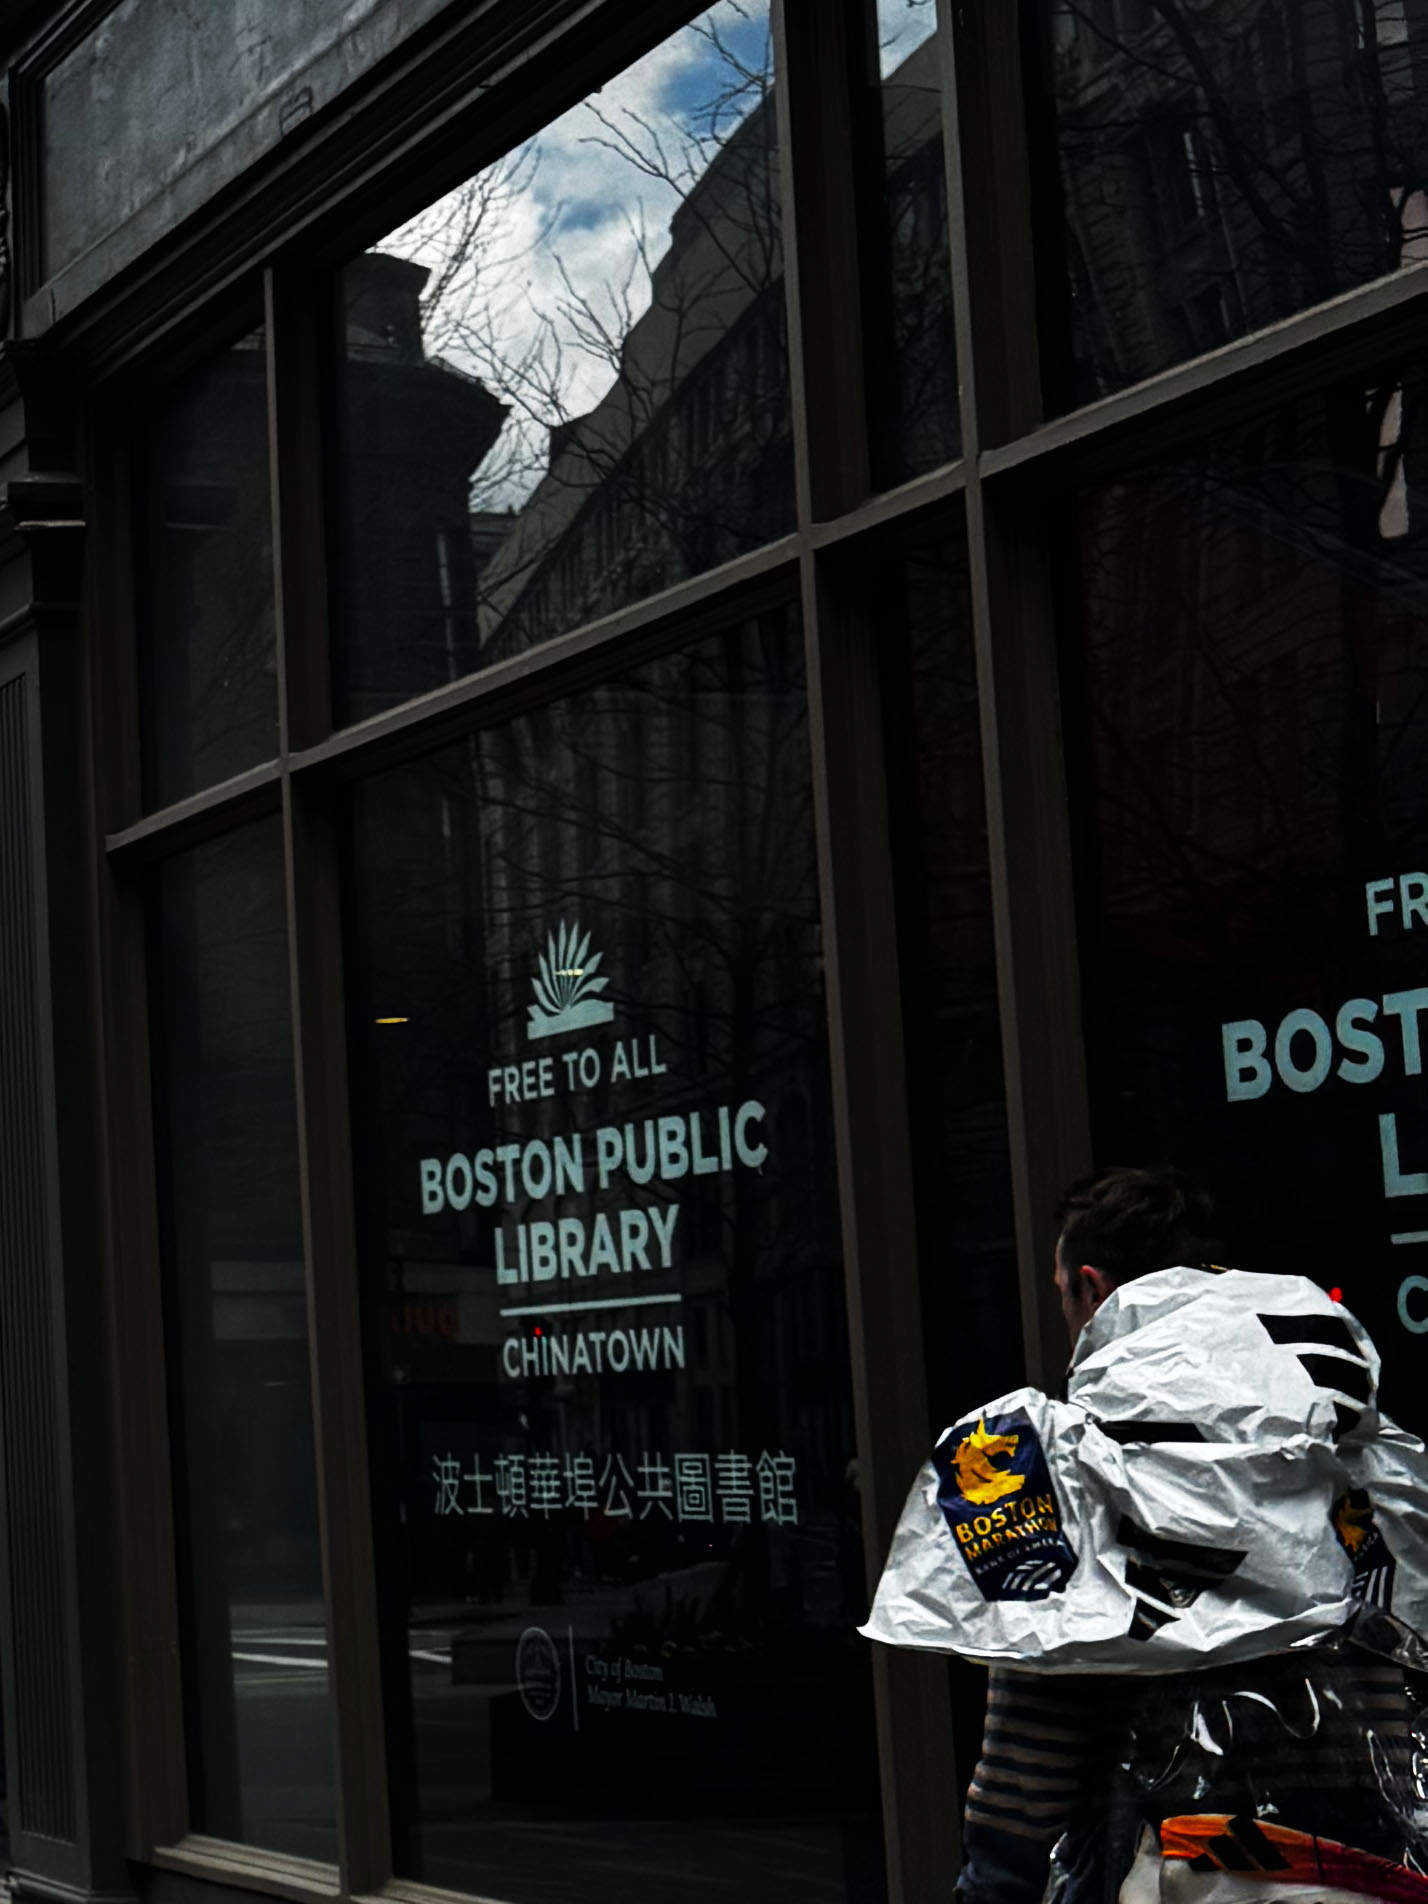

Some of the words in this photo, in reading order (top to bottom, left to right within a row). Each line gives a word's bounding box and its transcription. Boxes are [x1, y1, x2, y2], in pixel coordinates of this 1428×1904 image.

[488, 1057, 555, 1107] FREE
[563, 1048, 601, 1091] TO
[610, 1034, 668, 1084] ALL
[420, 1134, 585, 1214] BOSTON
[596, 1100, 769, 1190] PUBLIC
[494, 1203, 680, 1285] LIBRARY
[503, 1325, 686, 1379] CHINATOWN
[432, 1448, 799, 1526] 波士頓華埠公共圖書館
[956, 1494, 1054, 1544] BOSTON
